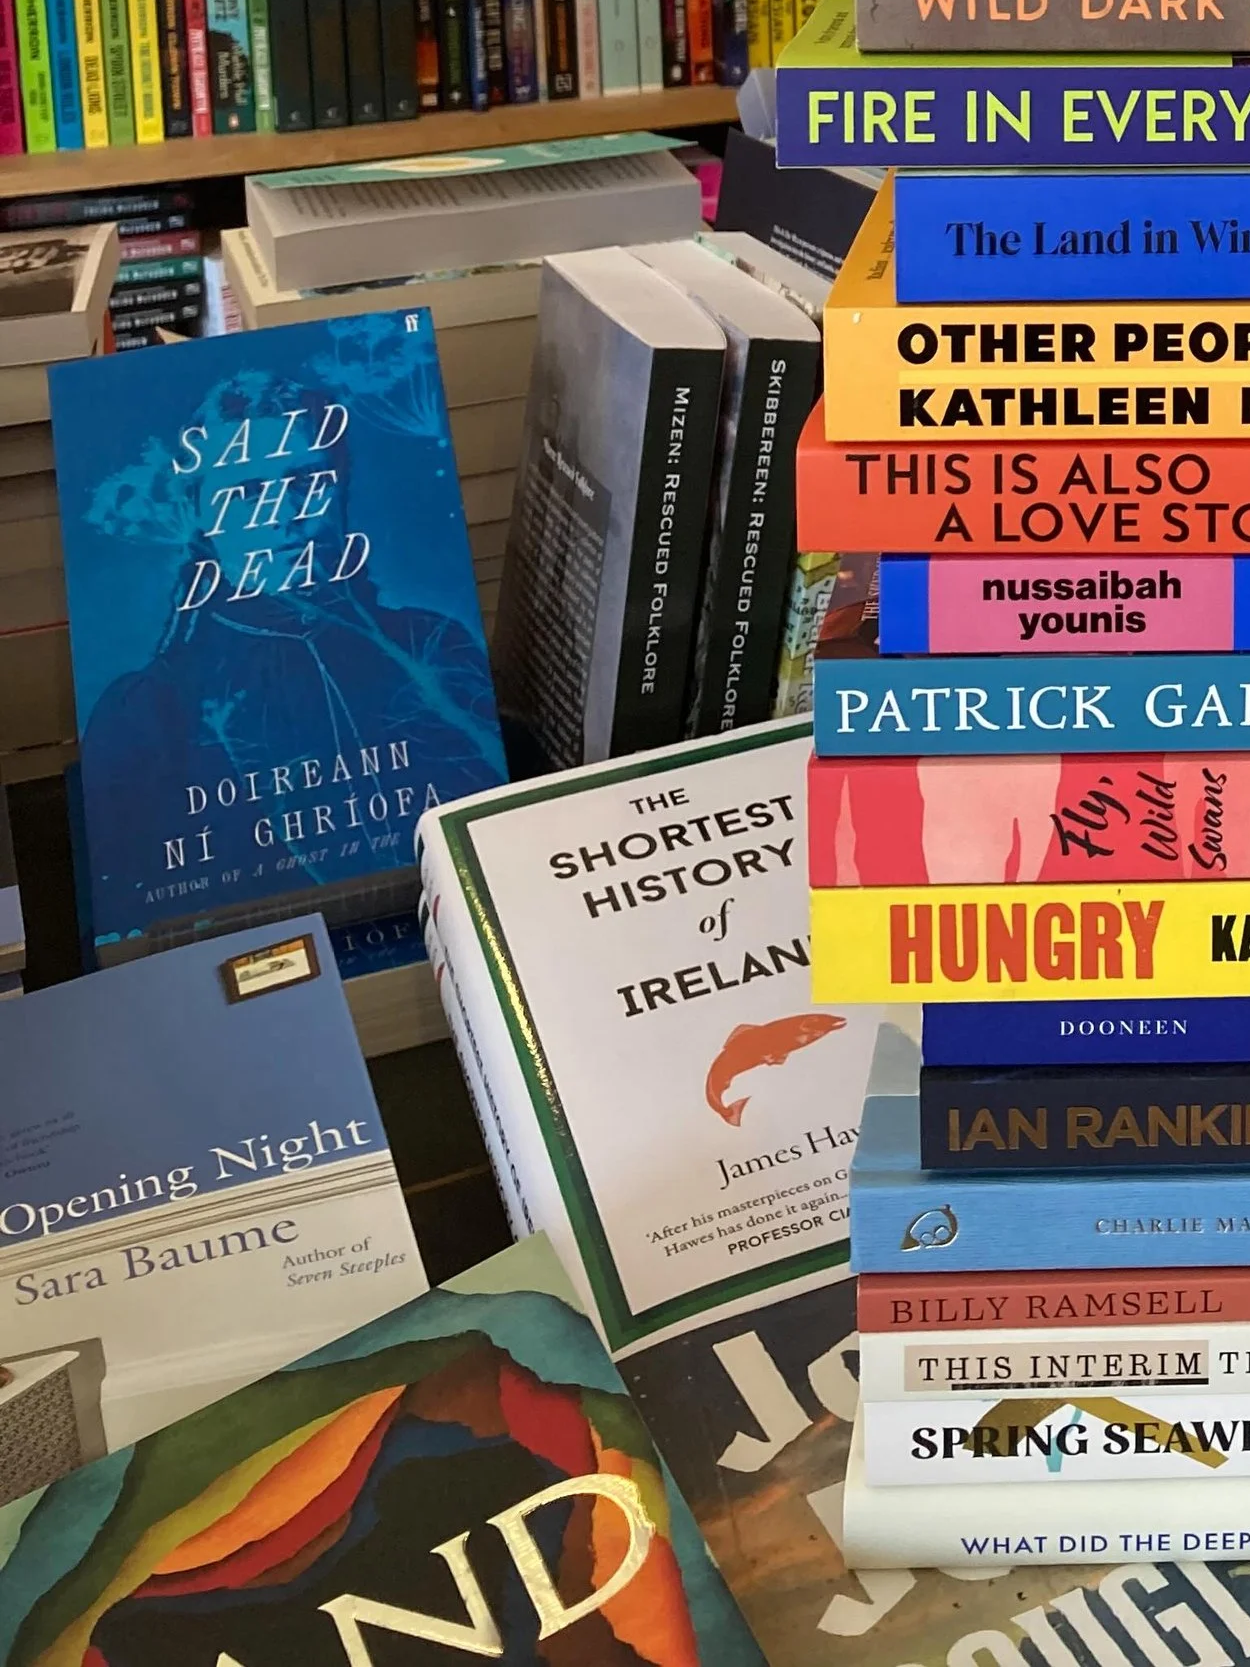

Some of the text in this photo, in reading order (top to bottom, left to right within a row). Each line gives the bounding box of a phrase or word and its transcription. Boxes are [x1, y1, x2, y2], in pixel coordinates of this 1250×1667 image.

[897, 323, 1096, 364] OTHER
[172, 403, 350, 475] SAID
[899, 387, 1210, 427] KATHLEEN
[203, 469, 339, 538] THE
[176, 532, 371, 613] DEAD
[641, 386, 691, 696] MIZEN: RESCUED FOLKLORE
[720, 358, 787, 732] SKIBBEREEN: RESCUED FOLKLORE
[186, 740, 412, 816] DOIREANN
[628, 787, 690, 816] THE
[162, 782, 443, 871] NÍ GHRÍOFA
[549, 794, 797, 881] SHORTEST
[1140, 771, 1179, 862] Wild
[1187, 768, 1227, 872] Swans
[581, 837, 797, 919] HISTORY
[697, 897, 736, 942] of
[890, 900, 1164, 984] HUNGRY
[616, 935, 812, 1019] IRELAN
[0, 1118, 372, 1236] Opening Night
[692, 1213, 714, 1227] his
[718, 1183, 810, 1220] masterpieces
[813, 1176, 833, 1188] on
[715, 1144, 802, 1190] James
[14, 1218, 300, 1306] Sara Baume
[282, 1236, 372, 1270] Author of
[727, 1215, 824, 1255] PROFESSOR
[1095, 1216, 1204, 1235] CHARLIE
[287, 1251, 406, 1289] Seven Steeples
[961, 1537, 1047, 1555] WHAT
[1072, 1536, 1108, 1554] DID
[1119, 1534, 1171, 1552] THE
